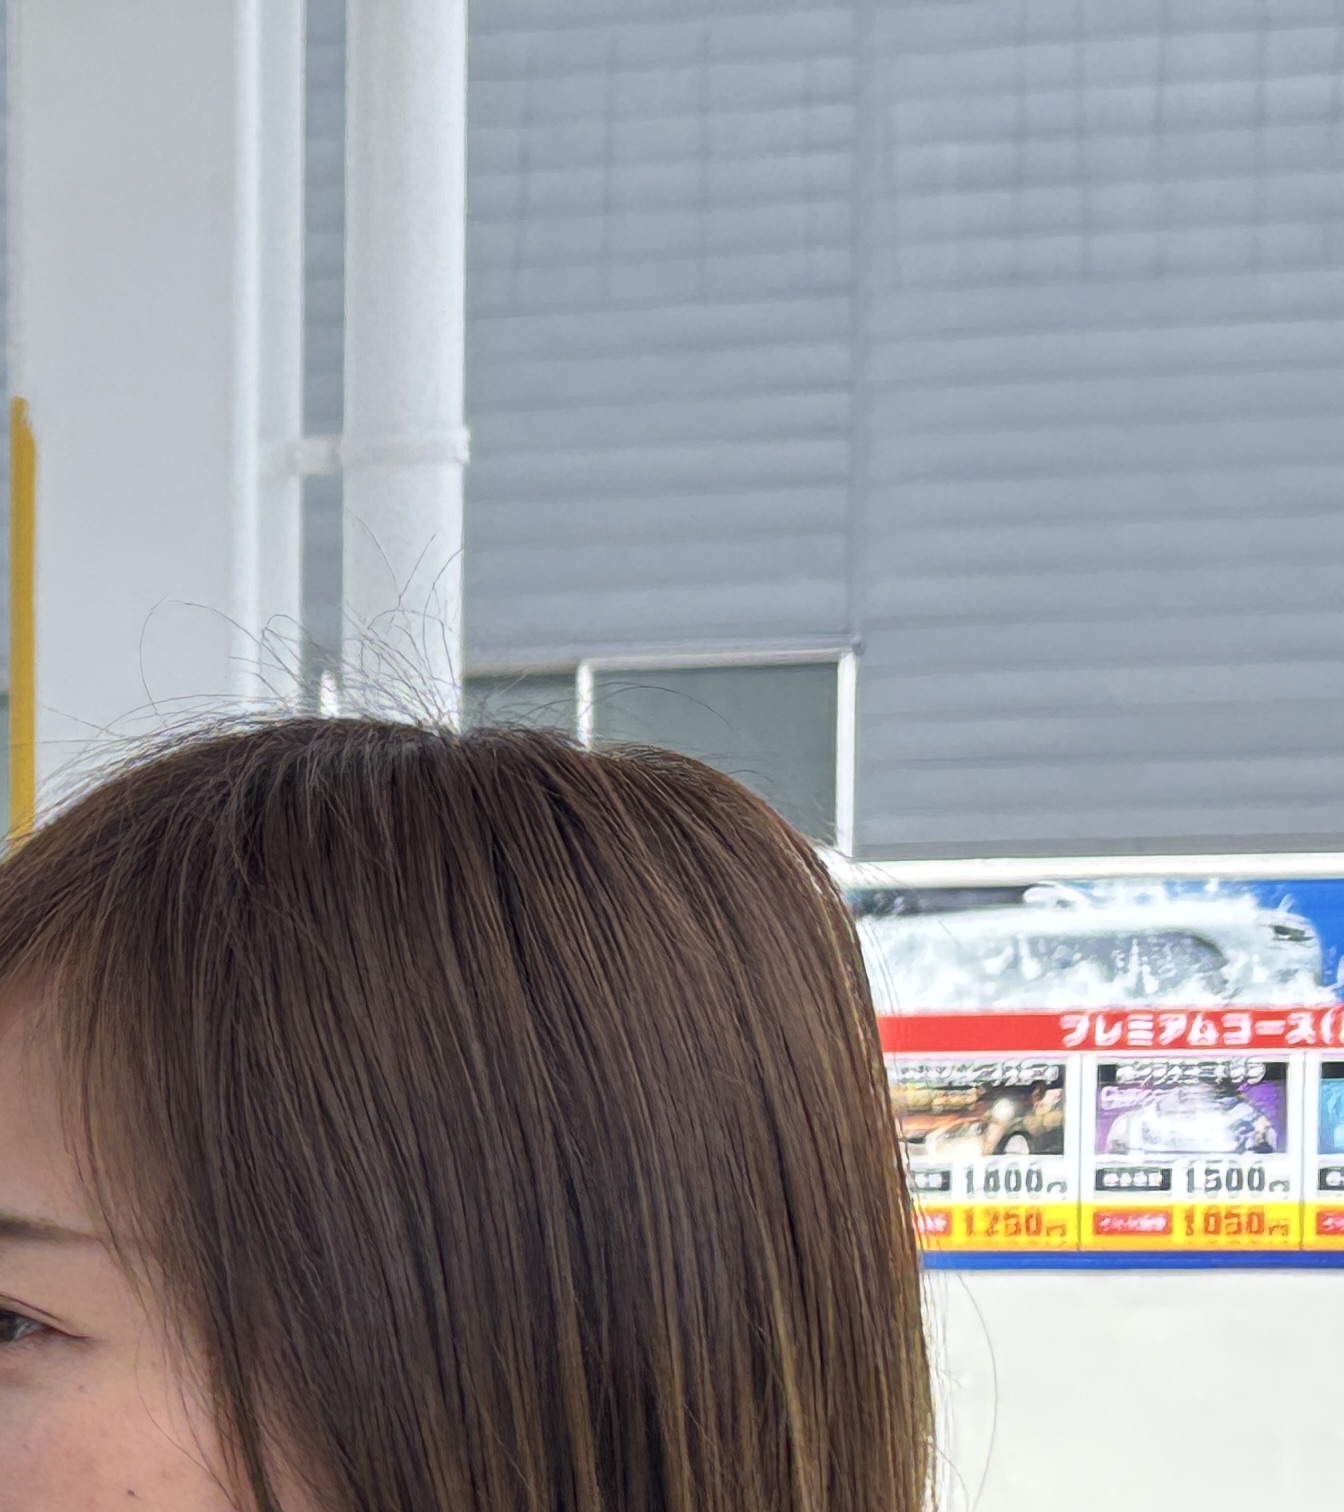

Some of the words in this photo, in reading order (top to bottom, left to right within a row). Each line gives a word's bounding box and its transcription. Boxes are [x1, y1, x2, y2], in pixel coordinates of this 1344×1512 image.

[1059, 1012, 1344, 1048] プレミアムコース(
